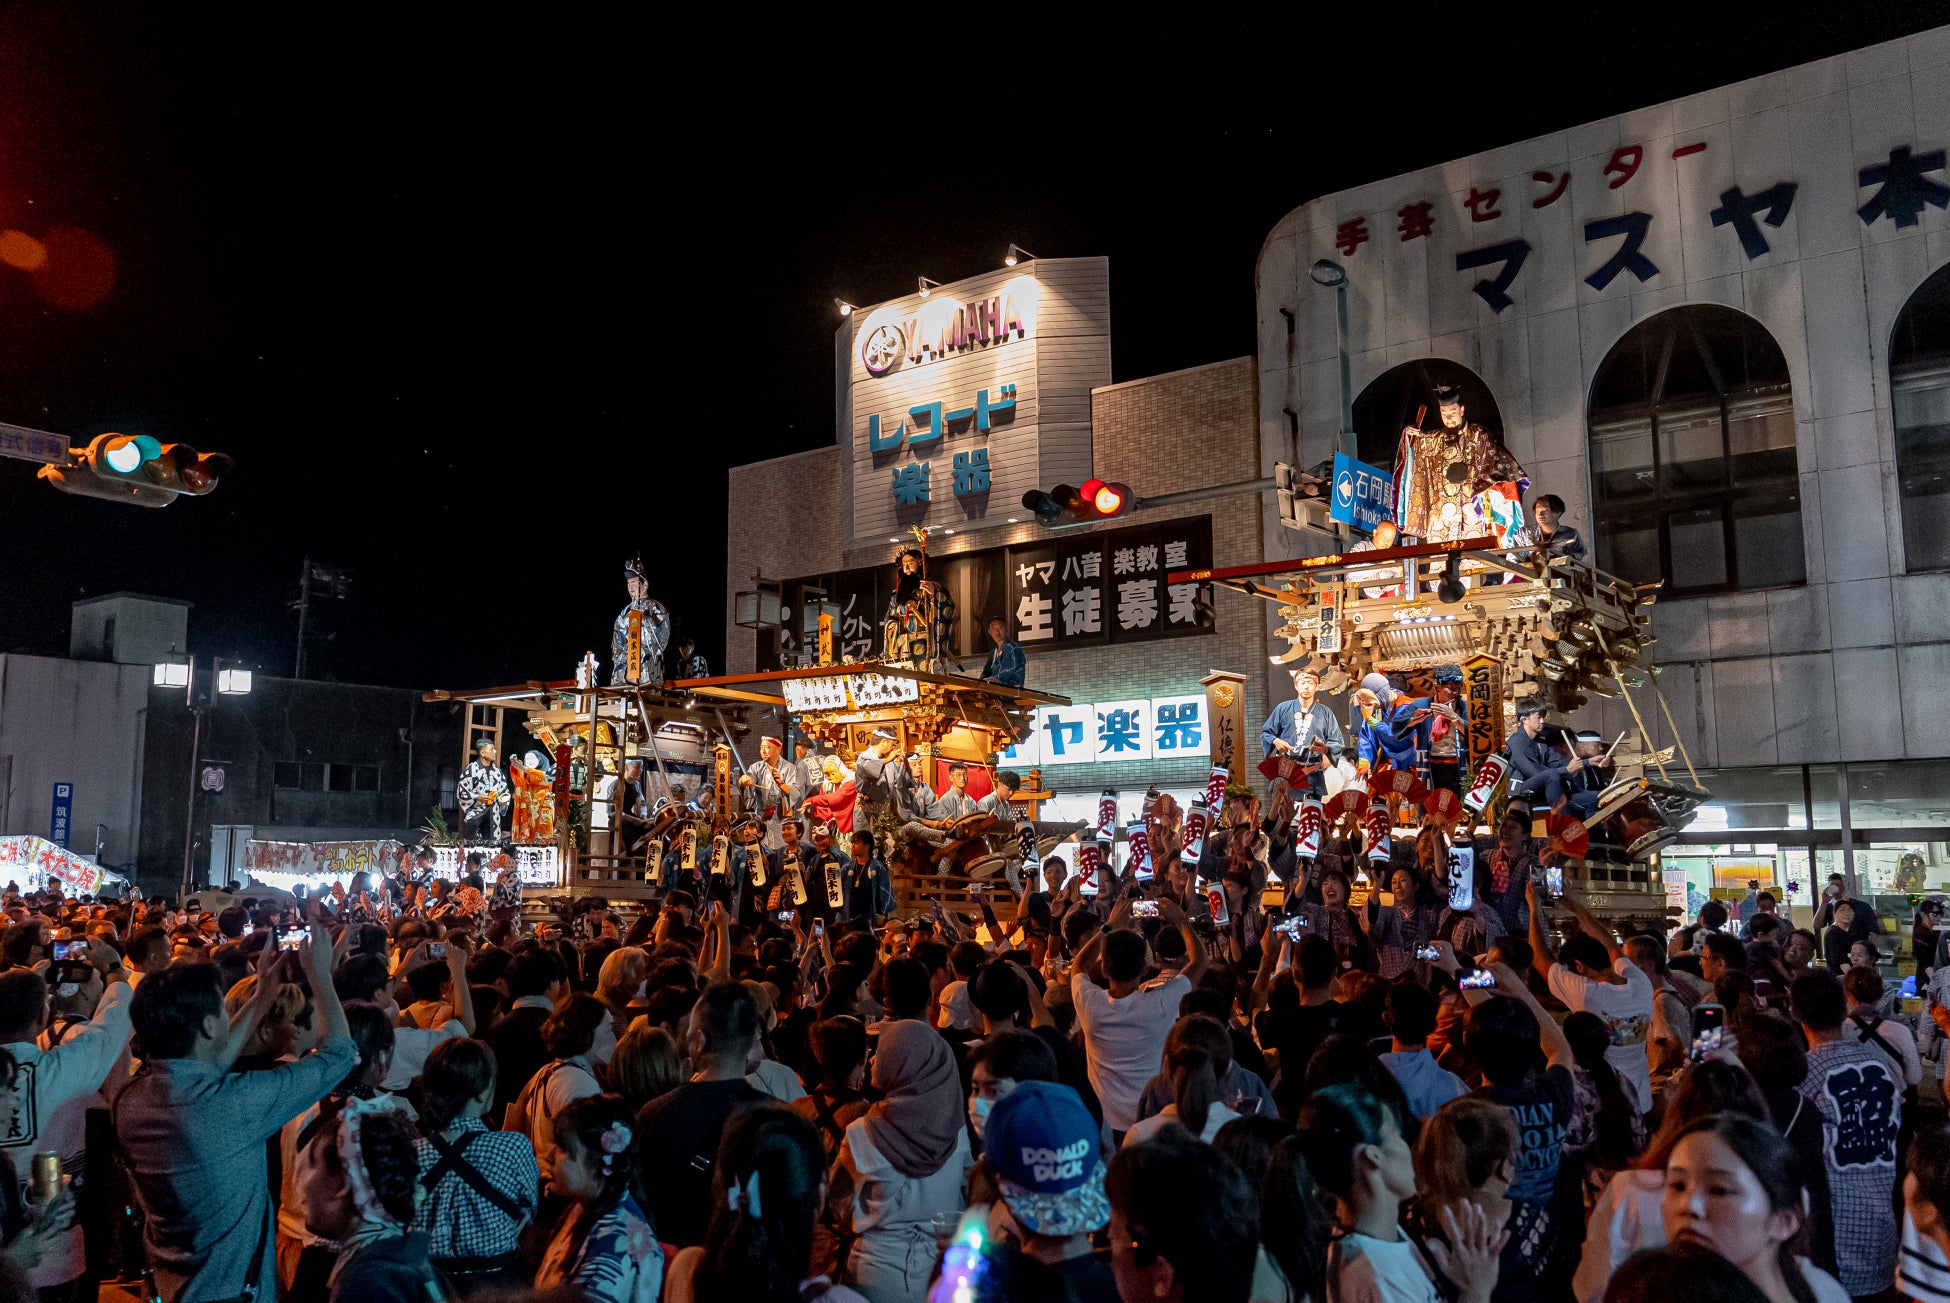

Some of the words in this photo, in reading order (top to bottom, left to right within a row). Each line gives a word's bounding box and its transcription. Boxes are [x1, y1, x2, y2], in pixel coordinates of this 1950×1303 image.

[1336, 143, 1706, 256] 手芸センター
[1455, 146, 1950, 315] マスヤ本
[903, 294, 1024, 364] YAMAHA
[869, 384, 1015, 453] レコード
[892, 447, 991, 505] 楽器
[1354, 502, 1381, 525] Ishioka
[820, 623, 831, 665] 神武
[1000, 703, 1203, 758] ヤ楽器
[59, 787, 67, 796] P
[39, 849, 96, 890] 大たこ焼
[1021, 1138, 1090, 1166] DONALD
[1033, 1160, 1083, 1182] DUCK
